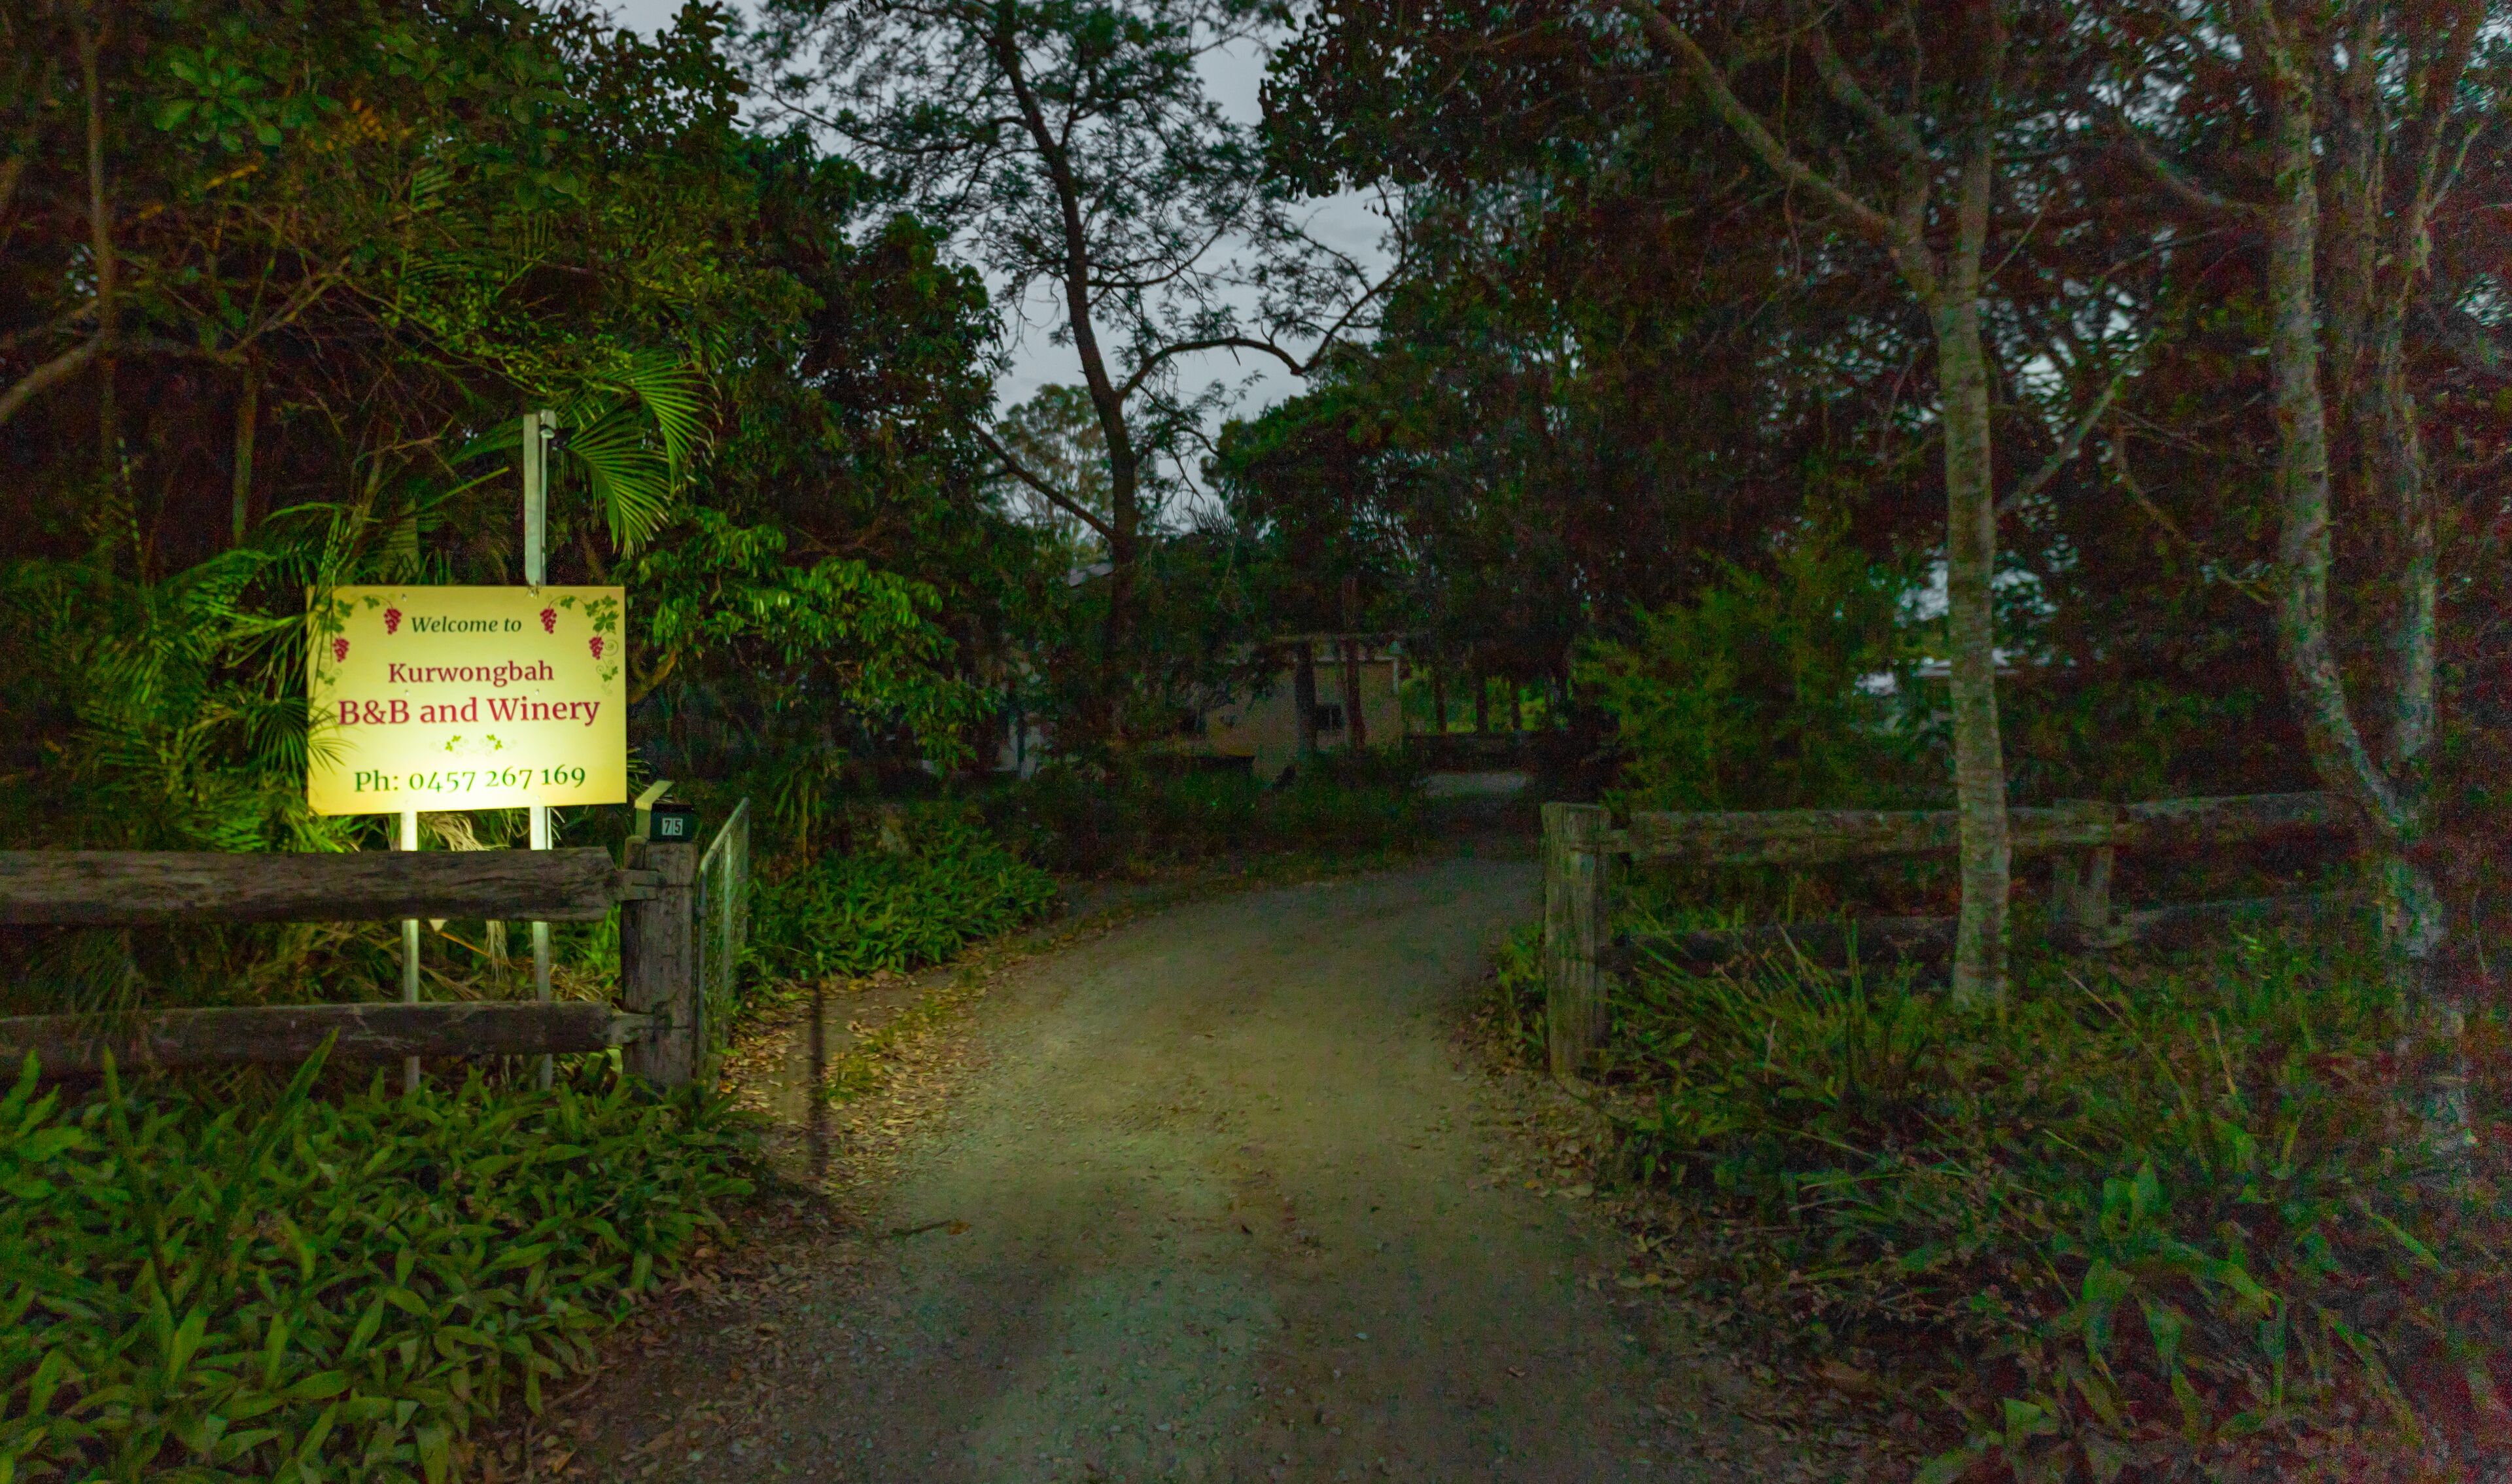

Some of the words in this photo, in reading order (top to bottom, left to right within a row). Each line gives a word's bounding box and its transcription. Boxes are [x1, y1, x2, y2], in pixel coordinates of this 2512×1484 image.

[411, 615, 498, 633] Welcome
[503, 617, 522, 632] to
[388, 660, 554, 687] Kurwongbah
[338, 699, 410, 725] B&B
[420, 697, 478, 723] and
[487, 696, 601, 727] Winery
[355, 770, 398, 793] Ph:
[409, 771, 476, 793] 0457
[485, 767, 532, 790] 267
[541, 765, 585, 787] 169
[665, 820, 681, 833] 75
